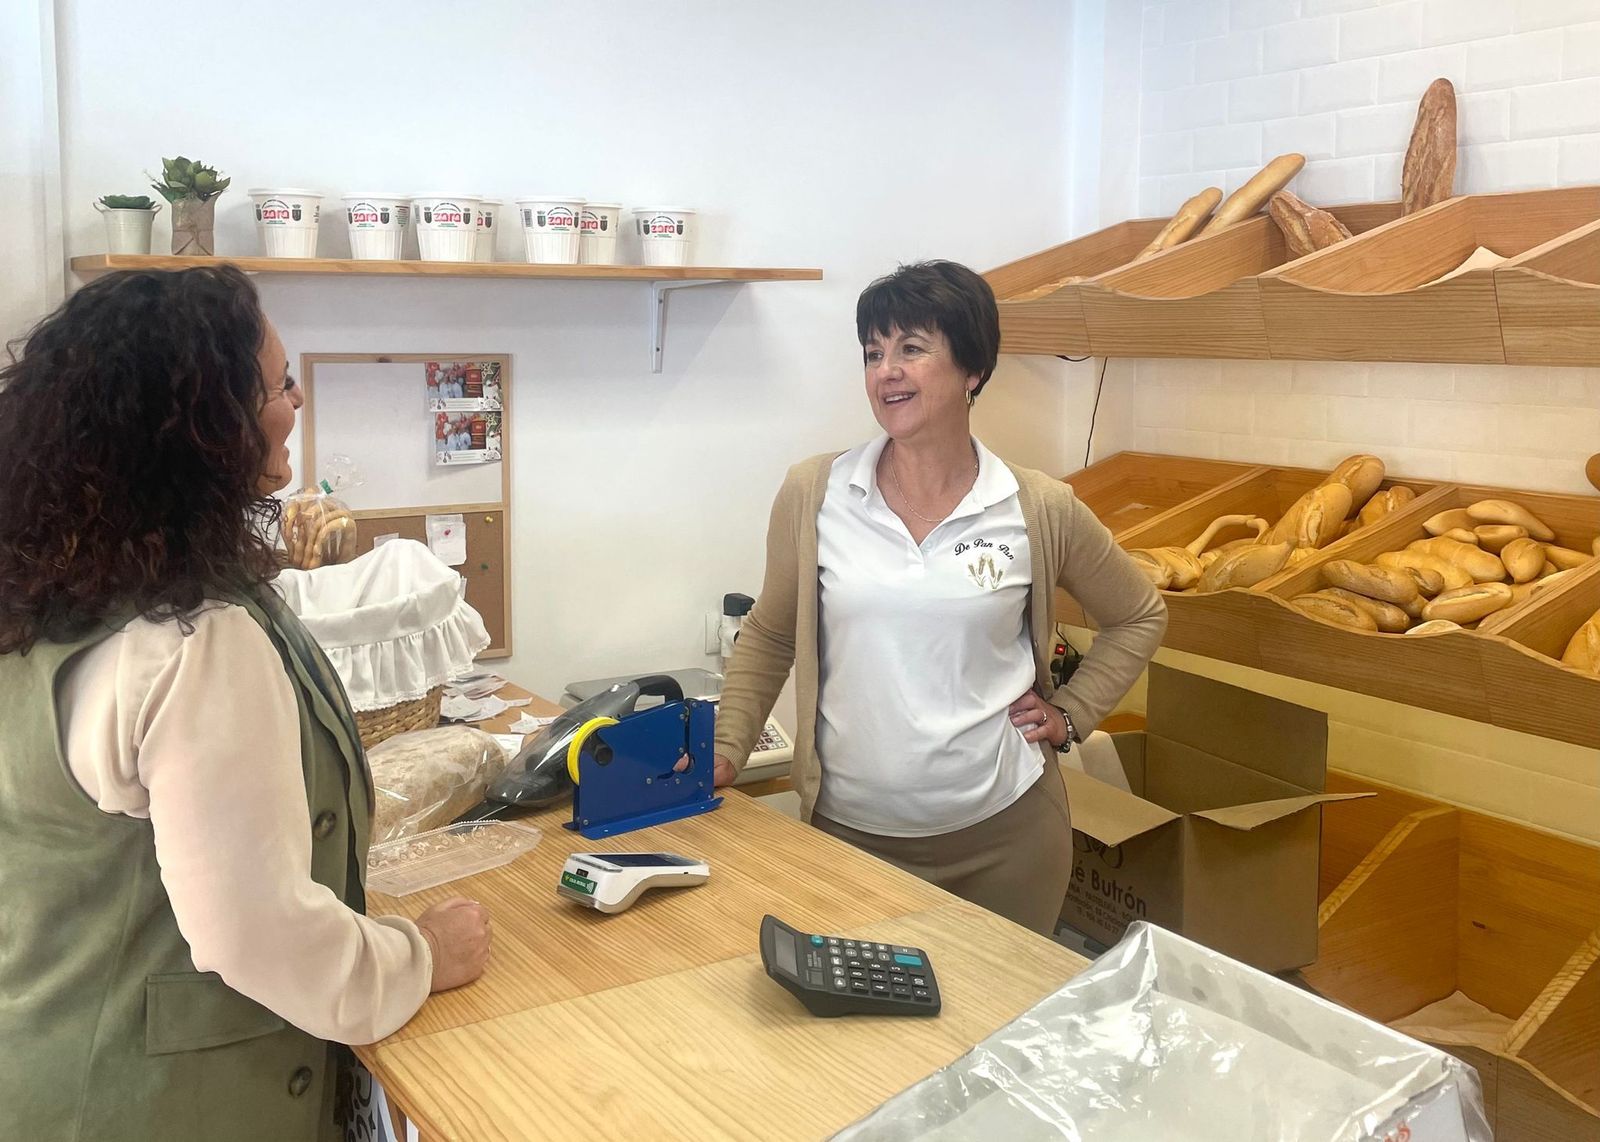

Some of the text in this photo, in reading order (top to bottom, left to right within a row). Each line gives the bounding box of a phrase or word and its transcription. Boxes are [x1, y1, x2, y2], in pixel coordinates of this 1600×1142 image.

[262, 209, 290, 220] zara
[353, 212, 378, 223] zara
[433, 212, 462, 223] zara
[548, 216, 573, 226] zara
[580, 220, 598, 230] ara
[650, 225, 675, 234] zara
[954, 538, 1015, 560] De Pan Pan
[1091, 869, 1147, 918] Butrón
